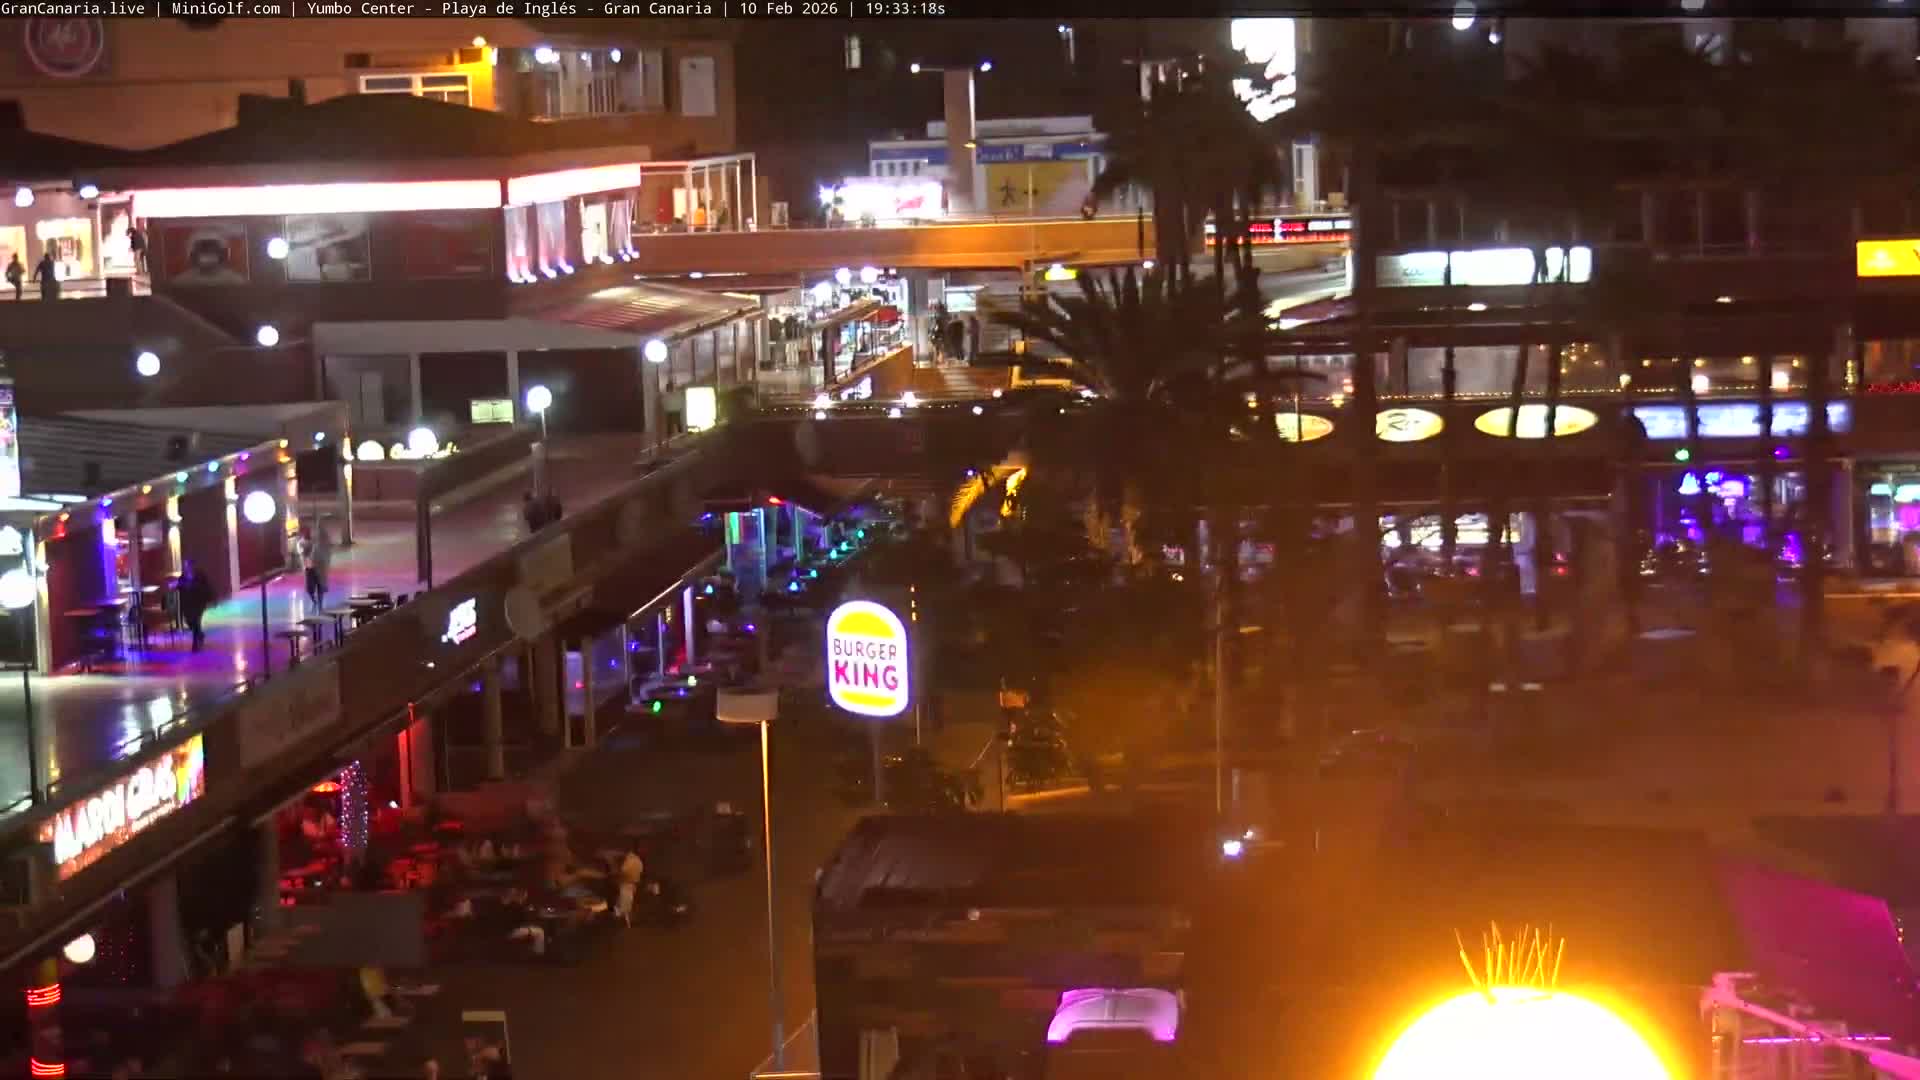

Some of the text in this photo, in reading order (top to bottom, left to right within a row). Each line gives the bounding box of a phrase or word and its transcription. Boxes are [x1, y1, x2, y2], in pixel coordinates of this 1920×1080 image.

[833, 638, 897, 661] BURGER
[834, 660, 899, 691] KING
[54, 783, 126, 865] MARDI
